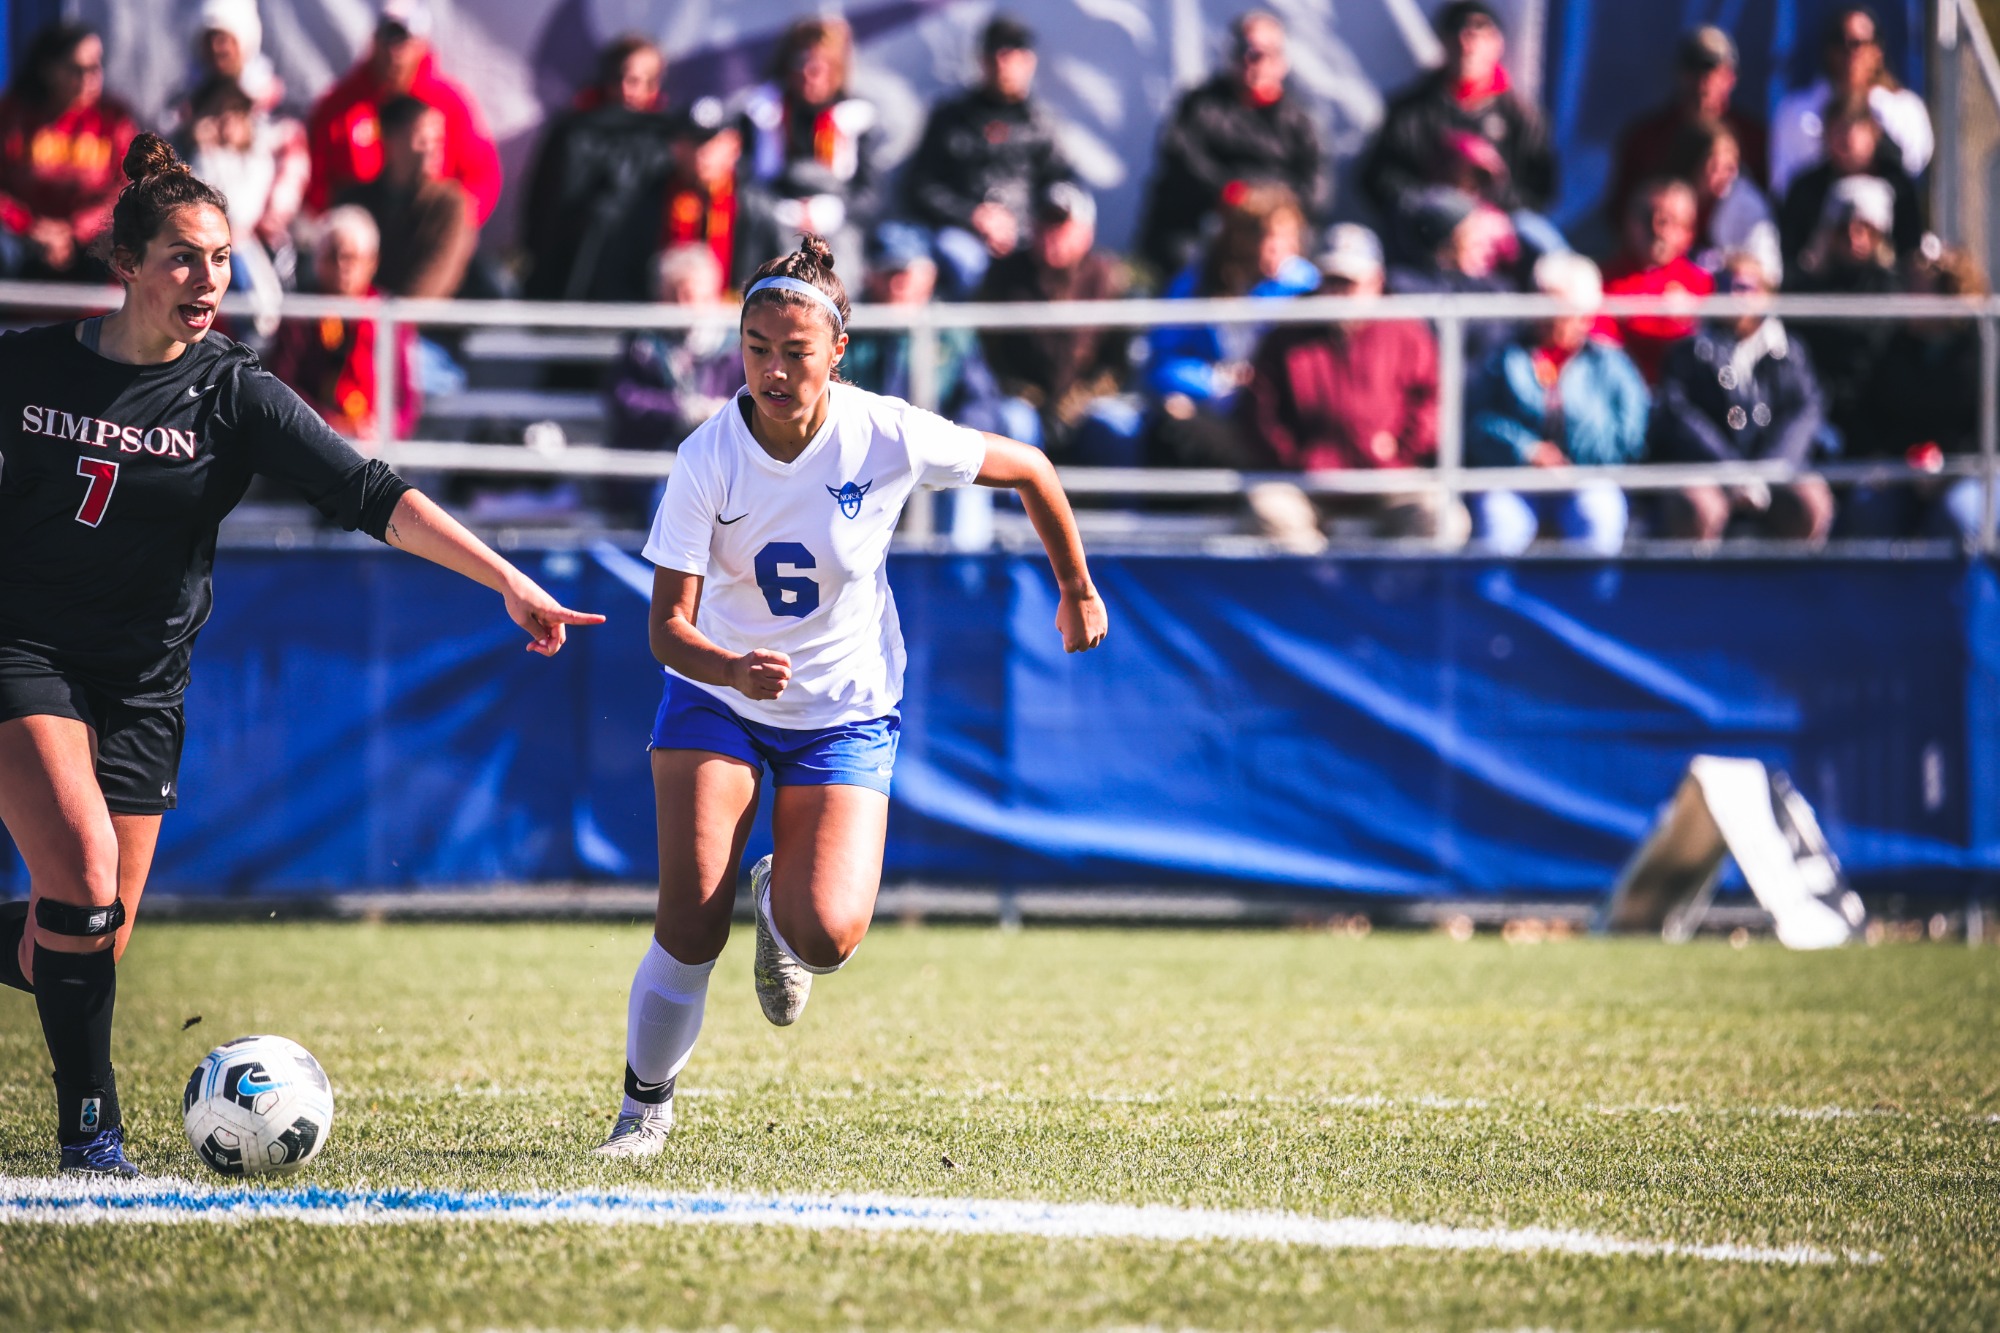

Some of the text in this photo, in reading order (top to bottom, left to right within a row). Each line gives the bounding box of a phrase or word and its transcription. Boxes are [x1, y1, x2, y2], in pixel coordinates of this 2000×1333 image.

[22, 405, 197, 460] SIMPSON
[75, 456, 119, 528] 7
[840, 492, 861, 502] NORSE
[754, 542, 819, 618] 6
